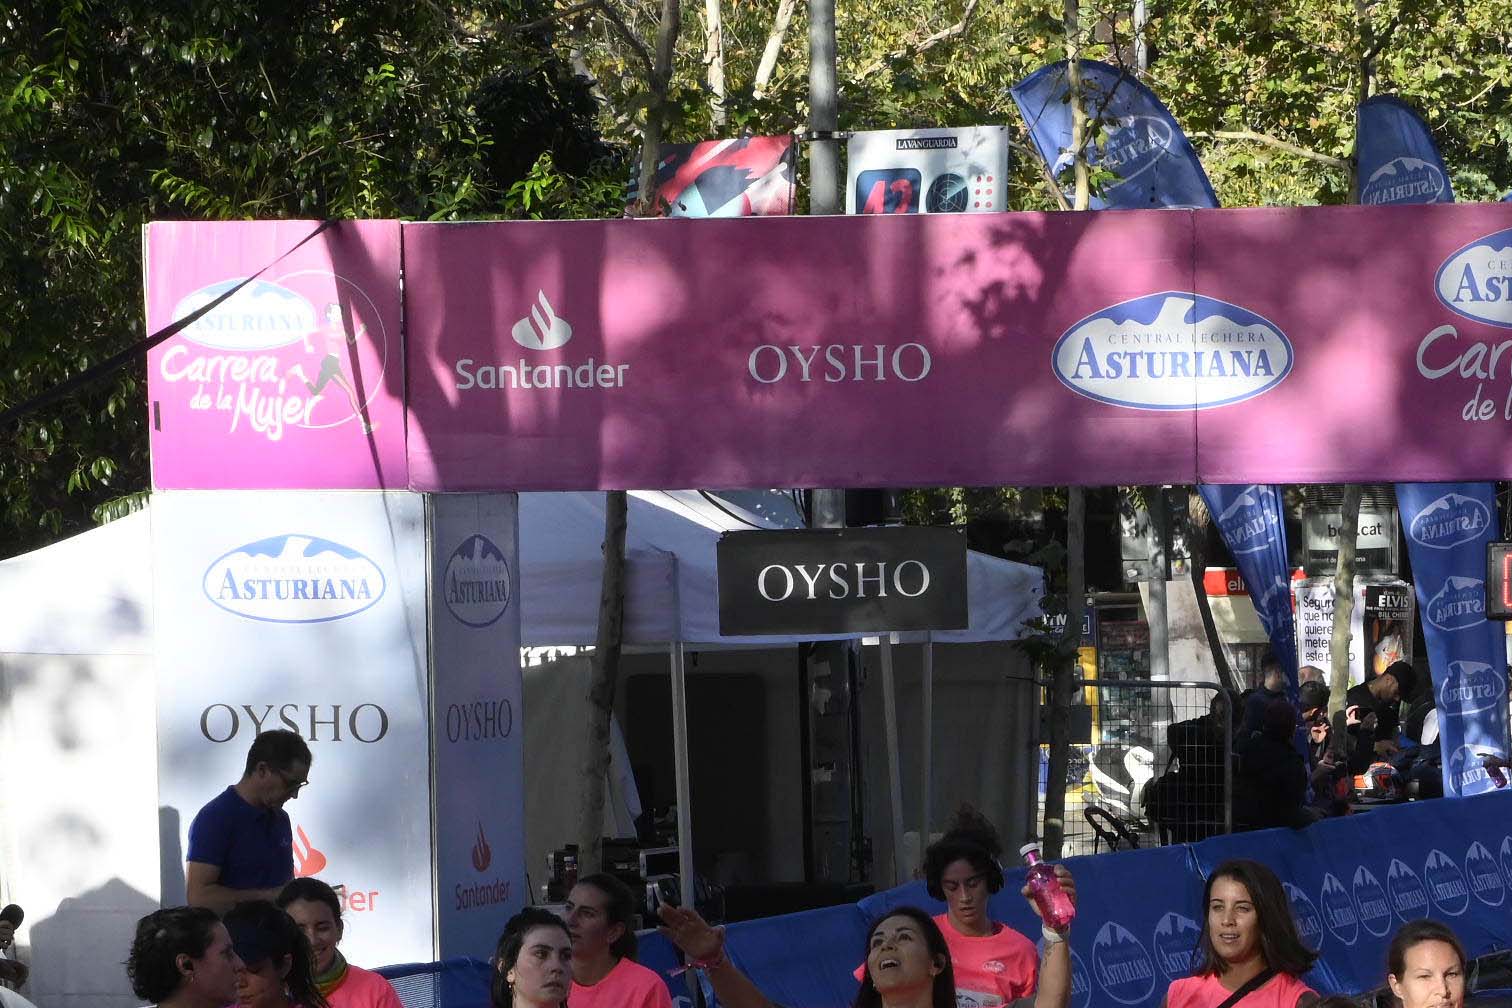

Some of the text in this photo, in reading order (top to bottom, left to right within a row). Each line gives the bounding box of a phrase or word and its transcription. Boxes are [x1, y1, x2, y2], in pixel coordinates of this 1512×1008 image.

[1108, 332, 1266, 345] CENTRAL LECHERA
[160, 345, 281, 382] Carrera
[455, 358, 629, 390] Santander
[748, 342, 931, 384] OYSHO
[1070, 338, 1275, 382] ASTURIANA
[190, 377, 326, 440] de la Mujer
[1462, 385, 1494, 421] de
[216, 567, 372, 601] ASTURIANA
[757, 560, 931, 601] OYSHO
[1378, 594, 1409, 607] ELVIS
[200, 703, 389, 743] OYSHO
[446, 699, 512, 743] OYSHO
[455, 879, 511, 911] Santander
